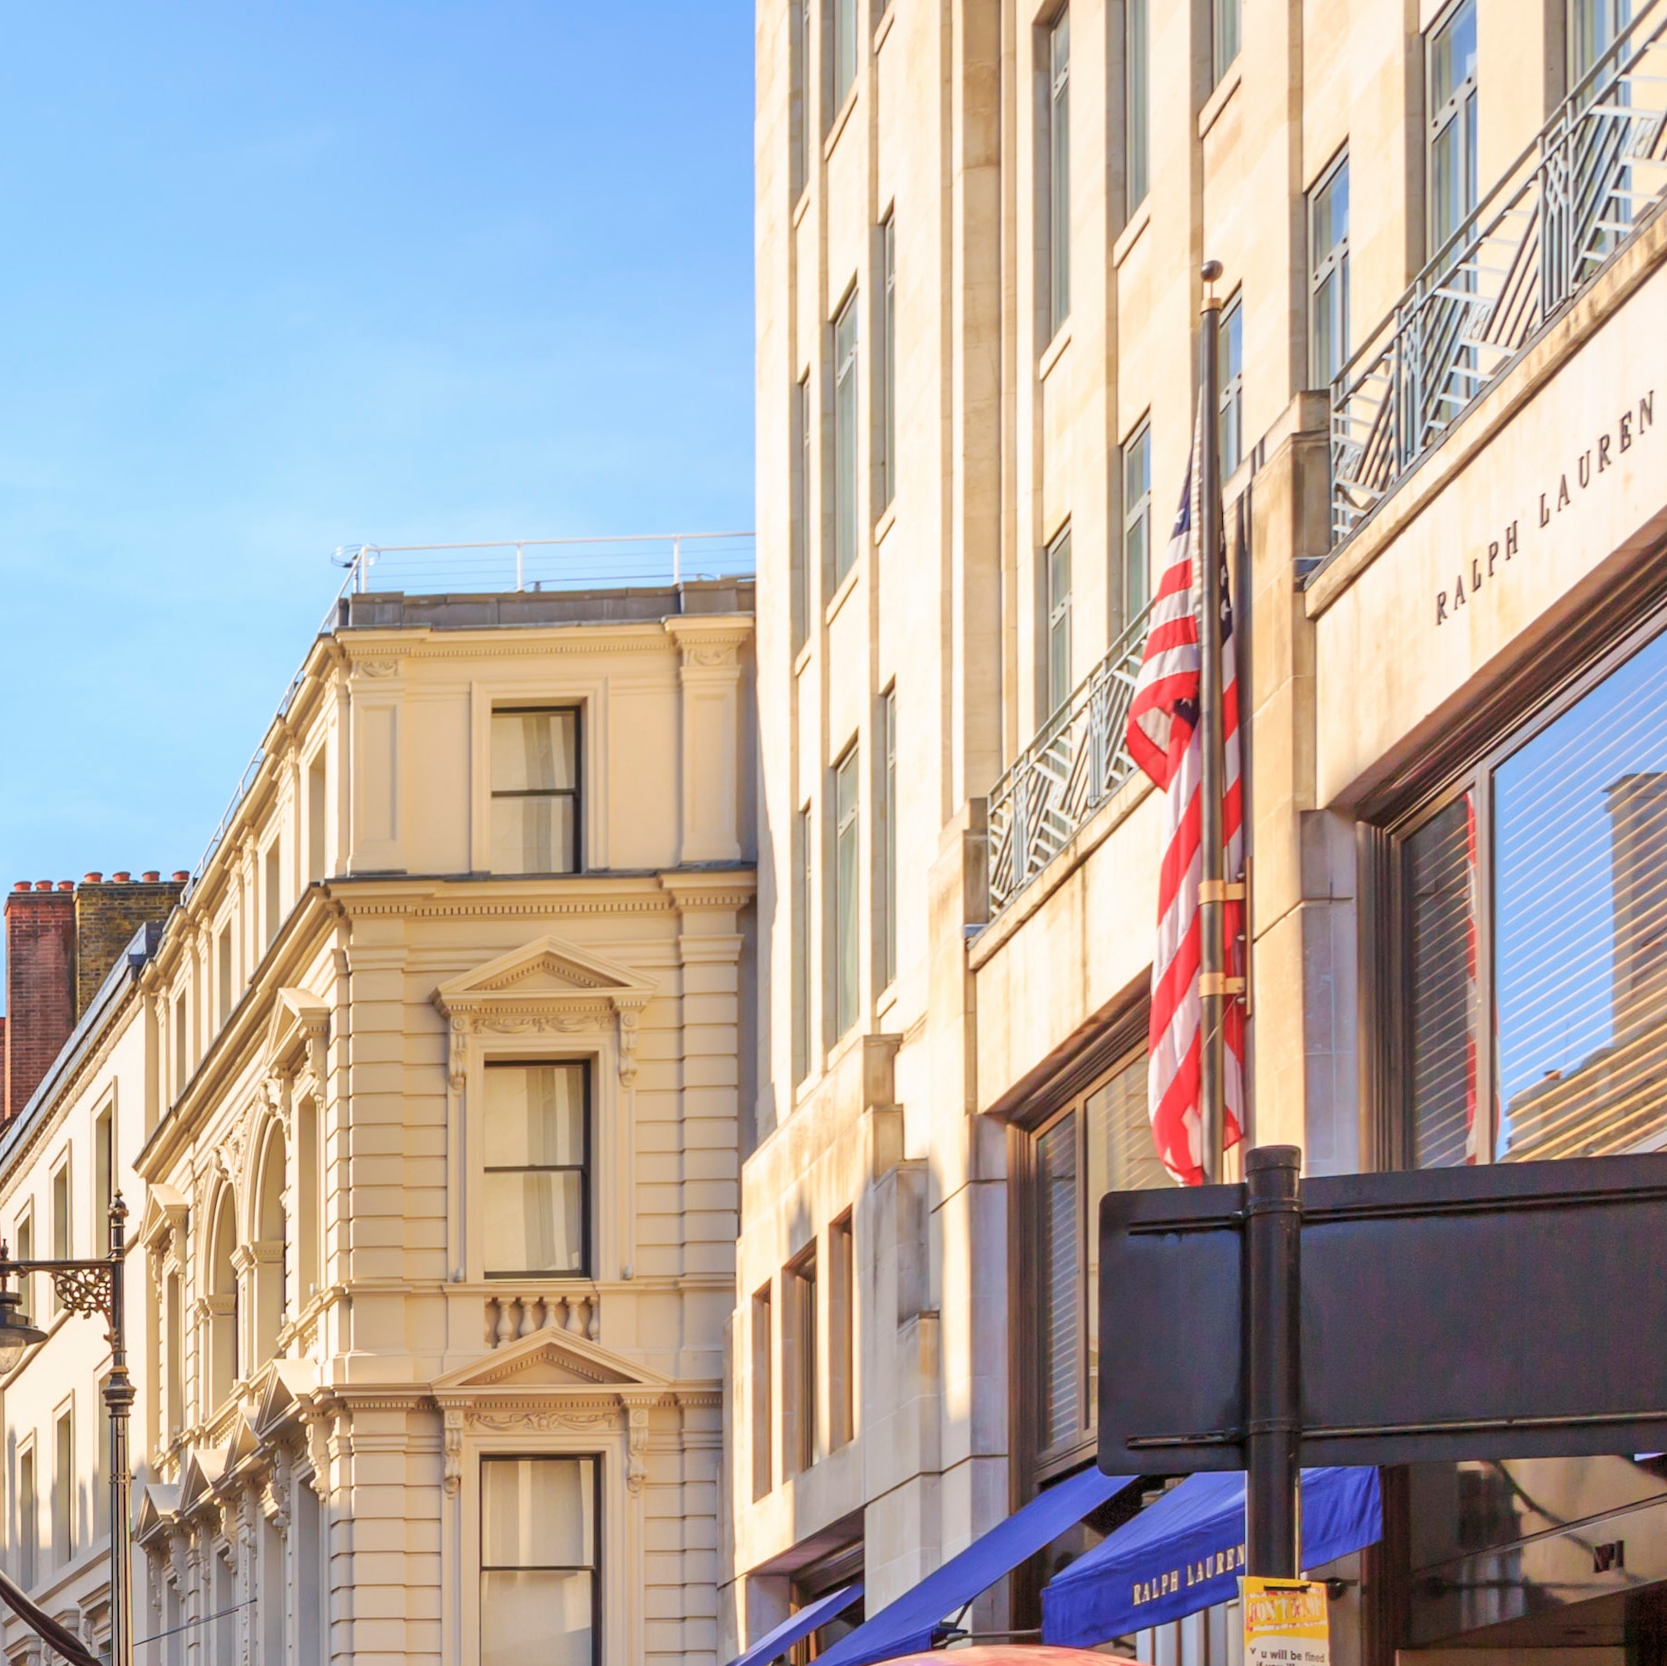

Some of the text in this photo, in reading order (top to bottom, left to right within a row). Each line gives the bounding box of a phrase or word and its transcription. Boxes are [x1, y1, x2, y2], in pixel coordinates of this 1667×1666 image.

[1436, 389, 1654, 626] RALPH LAUREN
[1132, 1543, 1246, 1606] RALPH LAUREN
[1270, 1649, 1287, 1660] will
[1290, 1651, 1302, 1661] be
[1305, 1651, 1325, 1663] fined
